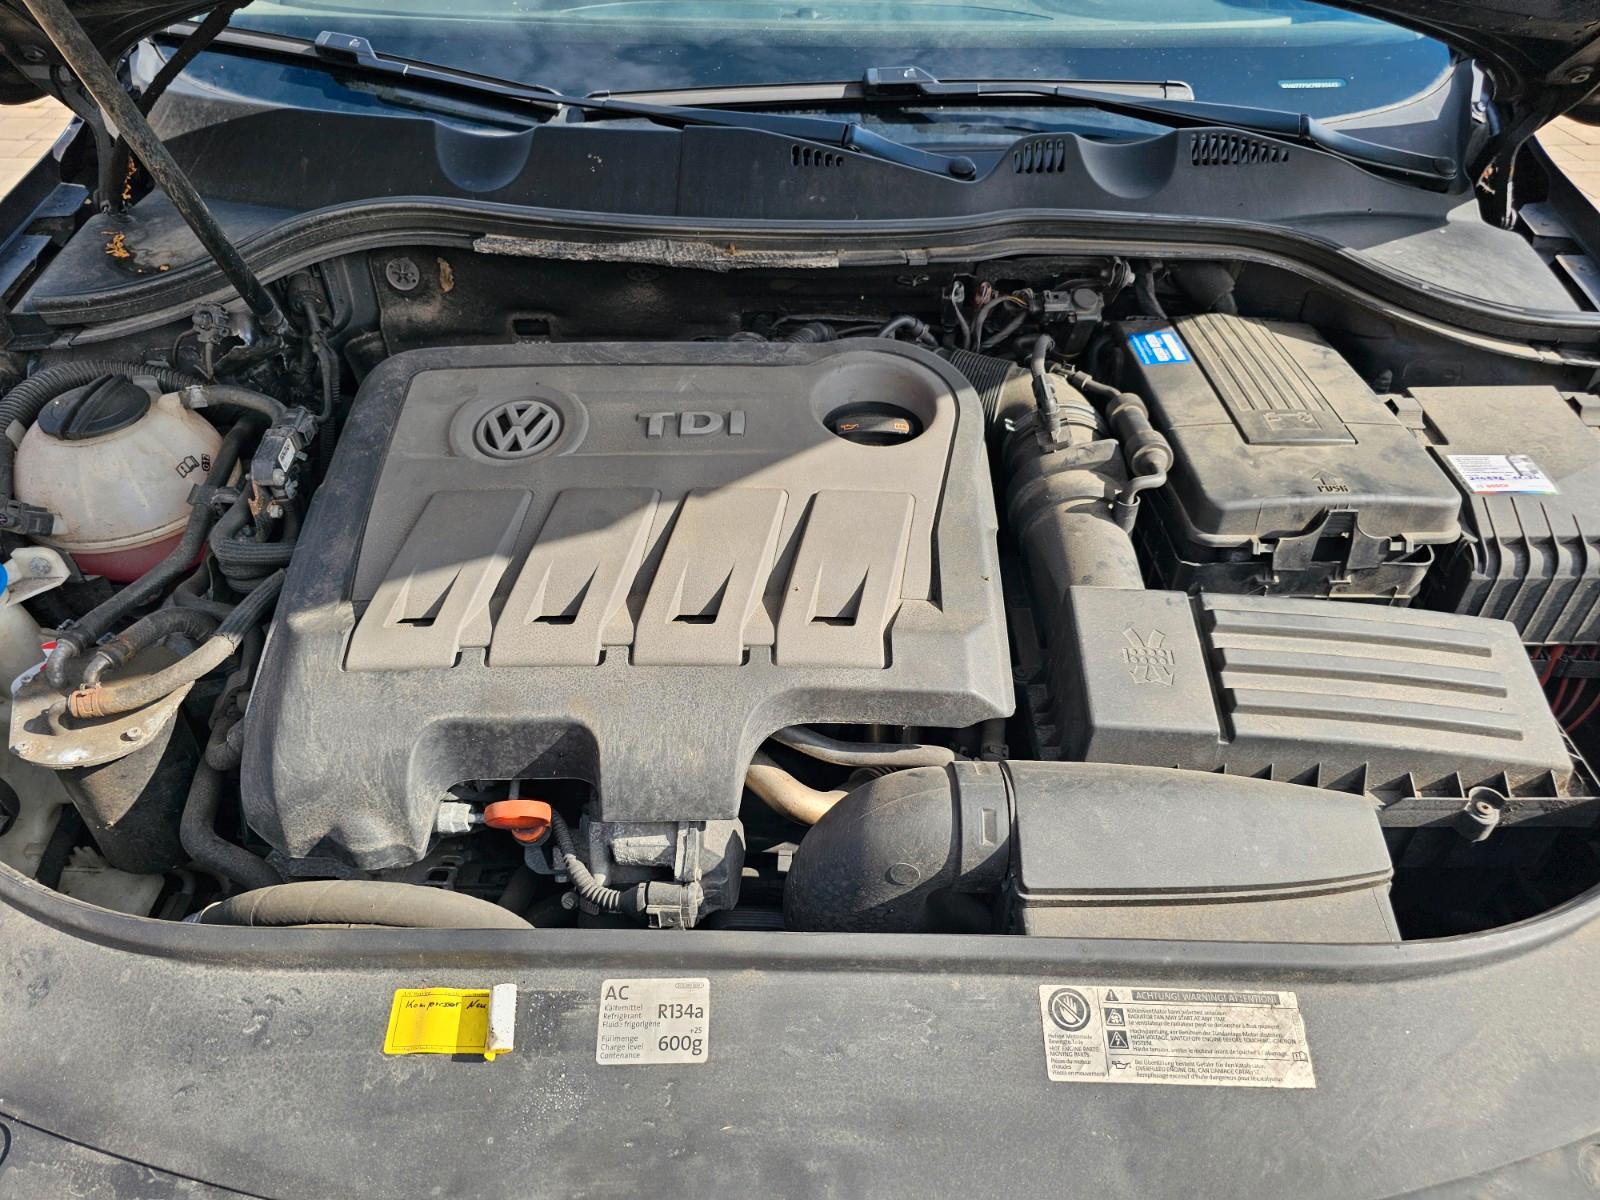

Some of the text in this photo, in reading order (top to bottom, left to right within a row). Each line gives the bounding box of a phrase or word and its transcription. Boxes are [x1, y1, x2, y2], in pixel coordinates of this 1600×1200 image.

[475, 400, 561, 457] VW
[636, 410, 746, 438] TDI
[604, 985, 630, 1001] AC
[1136, 991, 1180, 1001] ACHTUNG!
[1182, 993, 1226, 1002] WARNING!
[603, 1012, 642, 1021] Refrigerant
[658, 1003, 704, 1019] R134a
[600, 1042, 644, 1053] Charge level
[658, 1035, 703, 1056] 600g
